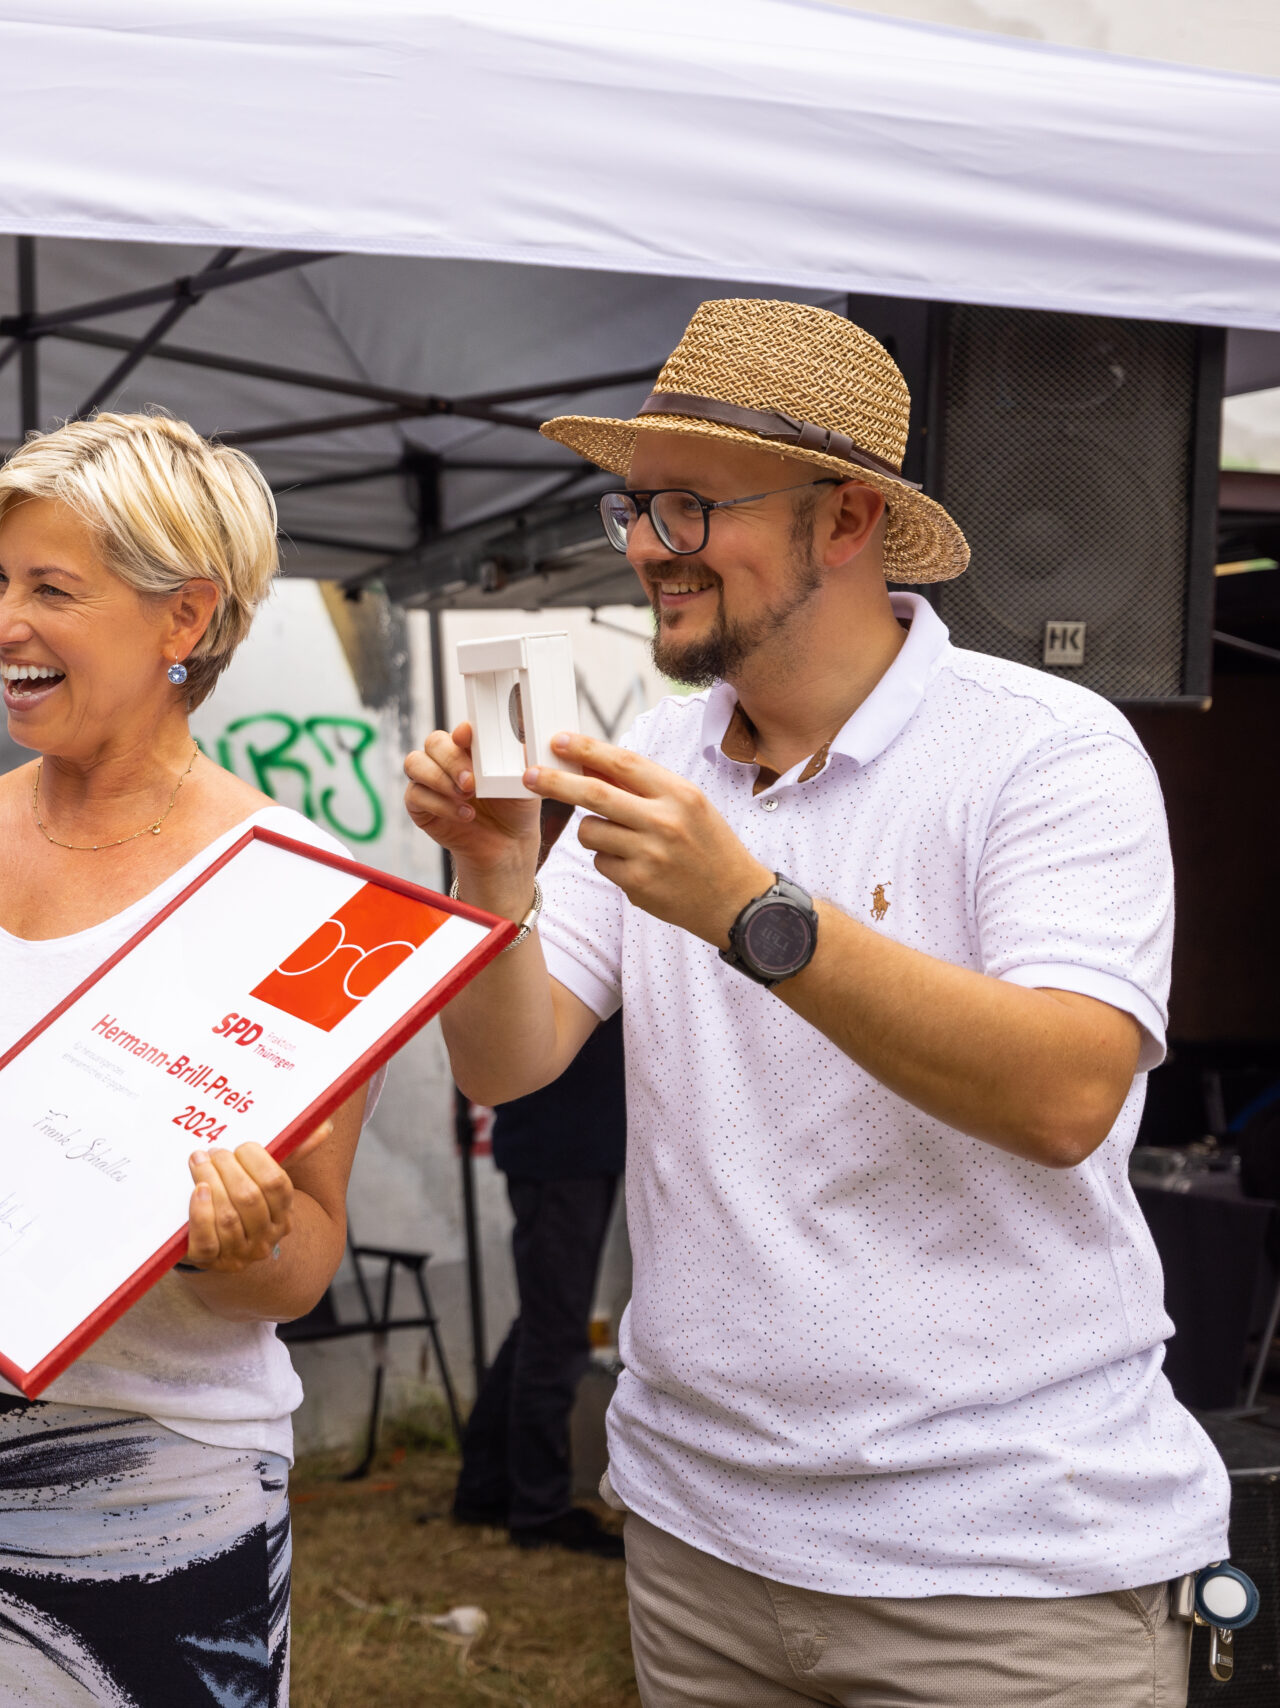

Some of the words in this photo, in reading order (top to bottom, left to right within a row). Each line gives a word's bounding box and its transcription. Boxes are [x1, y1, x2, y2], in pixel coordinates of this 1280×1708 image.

[1049, 627, 1081, 651] HK
[212, 1012, 264, 1046] SPD
[91, 1013, 254, 1113] Hermann-Brill-Preis
[253, 1043, 295, 1071] Thüringen
[33, 1109, 81, 1146] Frank
[171, 1105, 228, 1144] 2024
